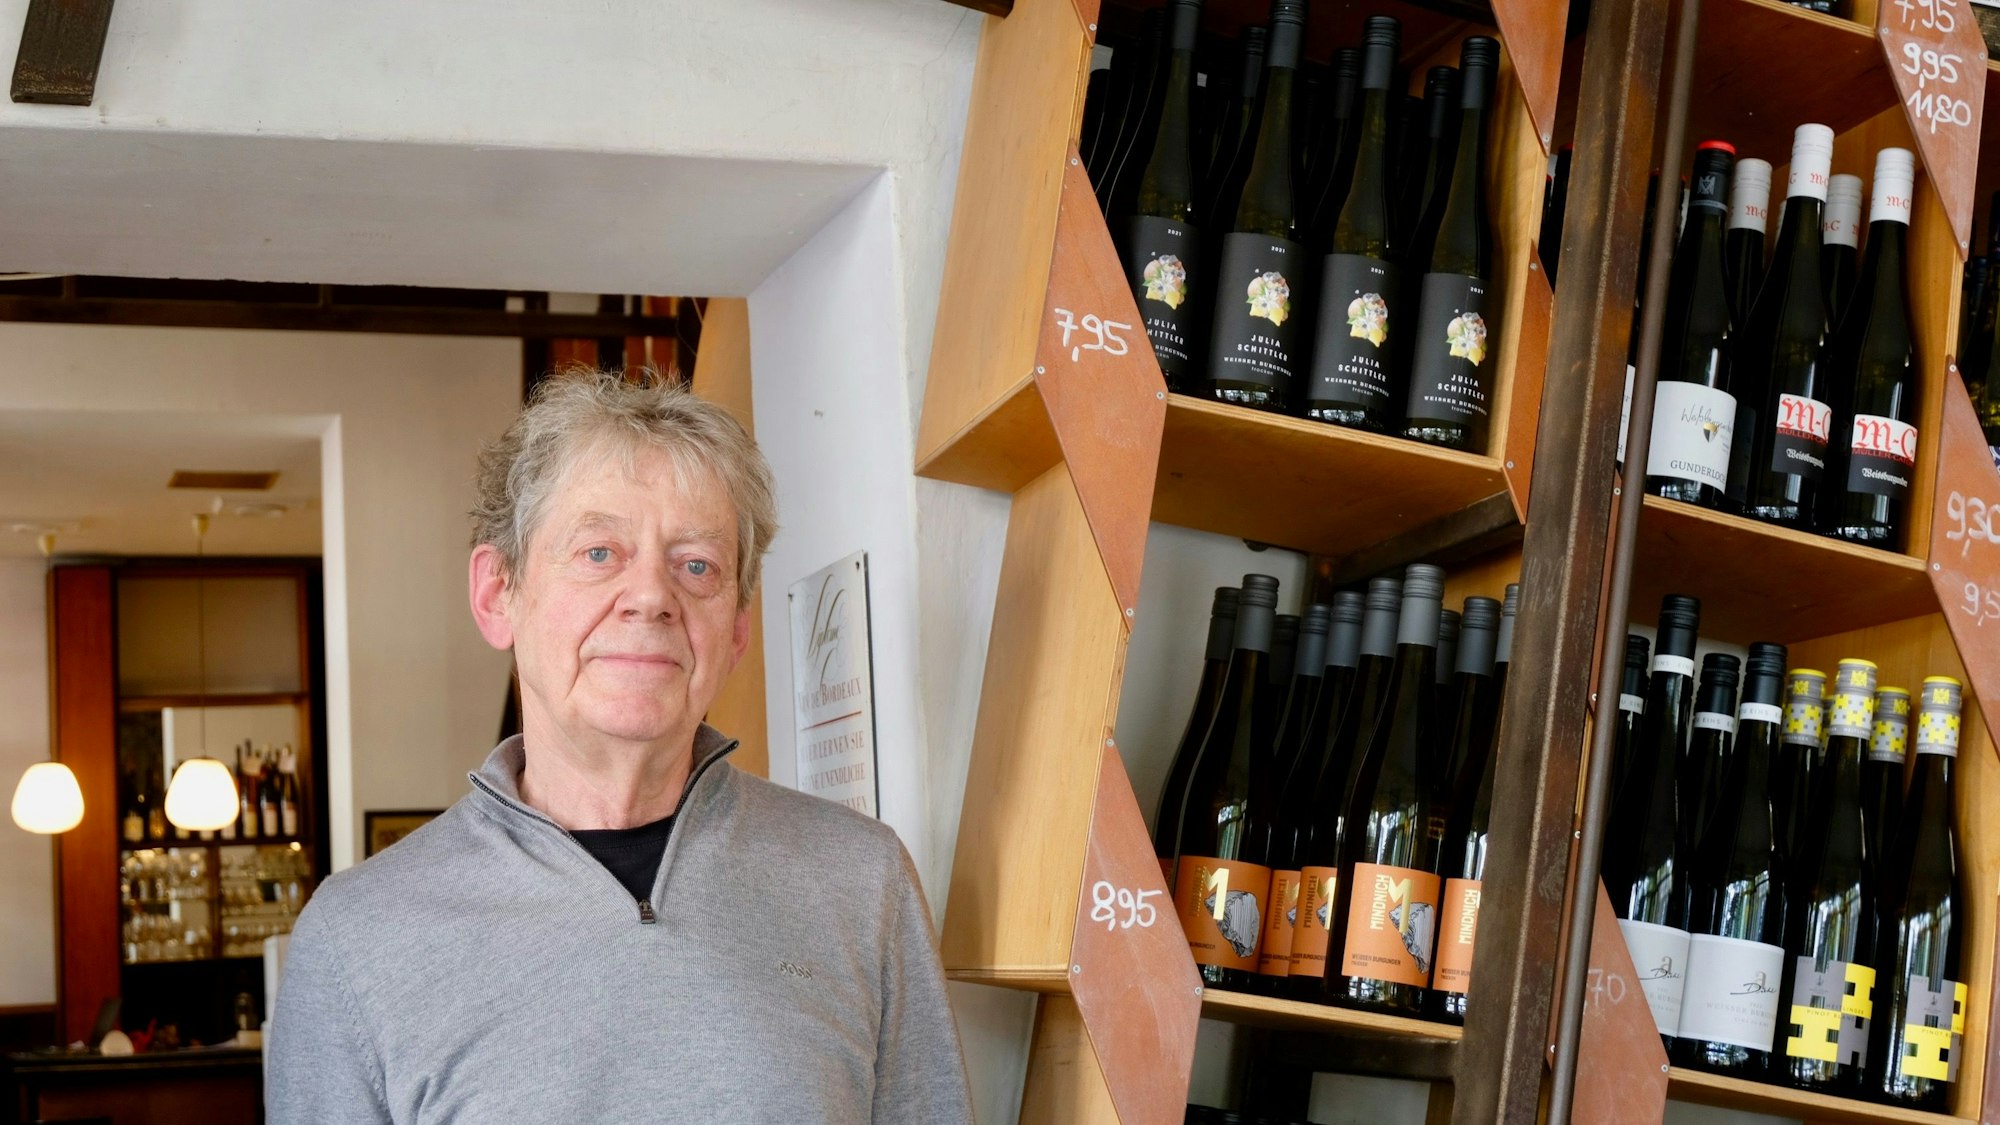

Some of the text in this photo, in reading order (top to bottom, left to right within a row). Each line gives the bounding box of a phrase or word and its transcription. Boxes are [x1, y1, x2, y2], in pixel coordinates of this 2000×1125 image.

[1901, 42, 1963, 88] 9,95
[1906, 89, 1971, 134] 11,80
[1167, 228, 1182, 237] 2021
[1271, 245, 1286, 254] 2021
[1370, 266, 1385, 276] 2021
[1470, 286, 1485, 295] 2021
[1147, 317, 1177, 331] JULIA
[1054, 307, 1132, 362] 7,95
[1147, 329, 1185, 346] HITTLER
[1251, 334, 1281, 348] JULIA
[1237, 343, 1288, 362] SCHITTLER
[1351, 355, 1380, 369] JULIA
[1338, 363, 1387, 383] SCHITTLER
[1451, 374, 1479, 388] JULIA
[1437, 382, 1485, 402] SCHITTLER
[1855, 417, 1918, 462] M-C
[1961, 582, 2000, 627] 9,5
[850, 730, 865, 750] SIE
[1091, 881, 1163, 931] 8,95
[1370, 874, 1390, 931] MINDNICH
[1458, 888, 1478, 945] MINDNICH
[1806, 1009, 1830, 1017] PINOT
